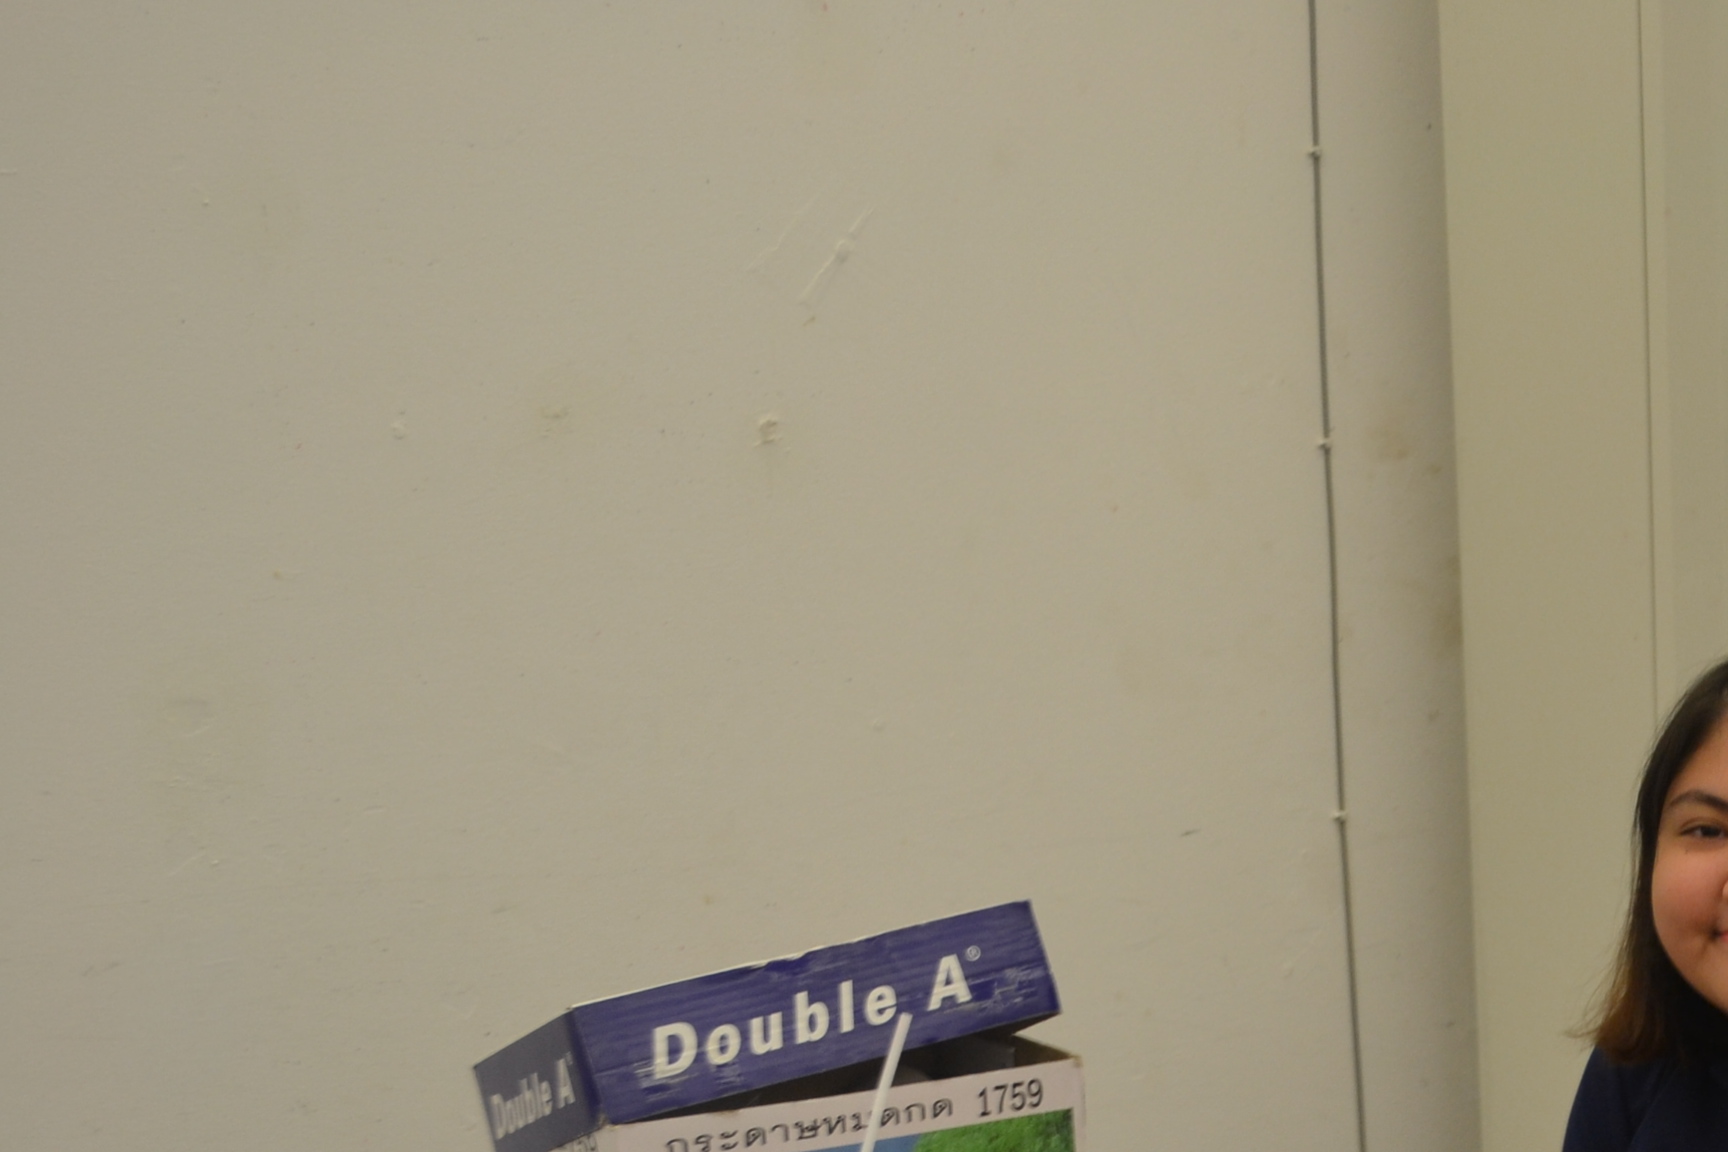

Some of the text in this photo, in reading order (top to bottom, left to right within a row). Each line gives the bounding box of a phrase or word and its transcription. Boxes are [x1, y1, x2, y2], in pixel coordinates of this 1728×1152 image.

[652, 979, 898, 1081] Double
[489, 1072, 553, 1140] Double
[977, 1078, 1044, 1118] 1759
